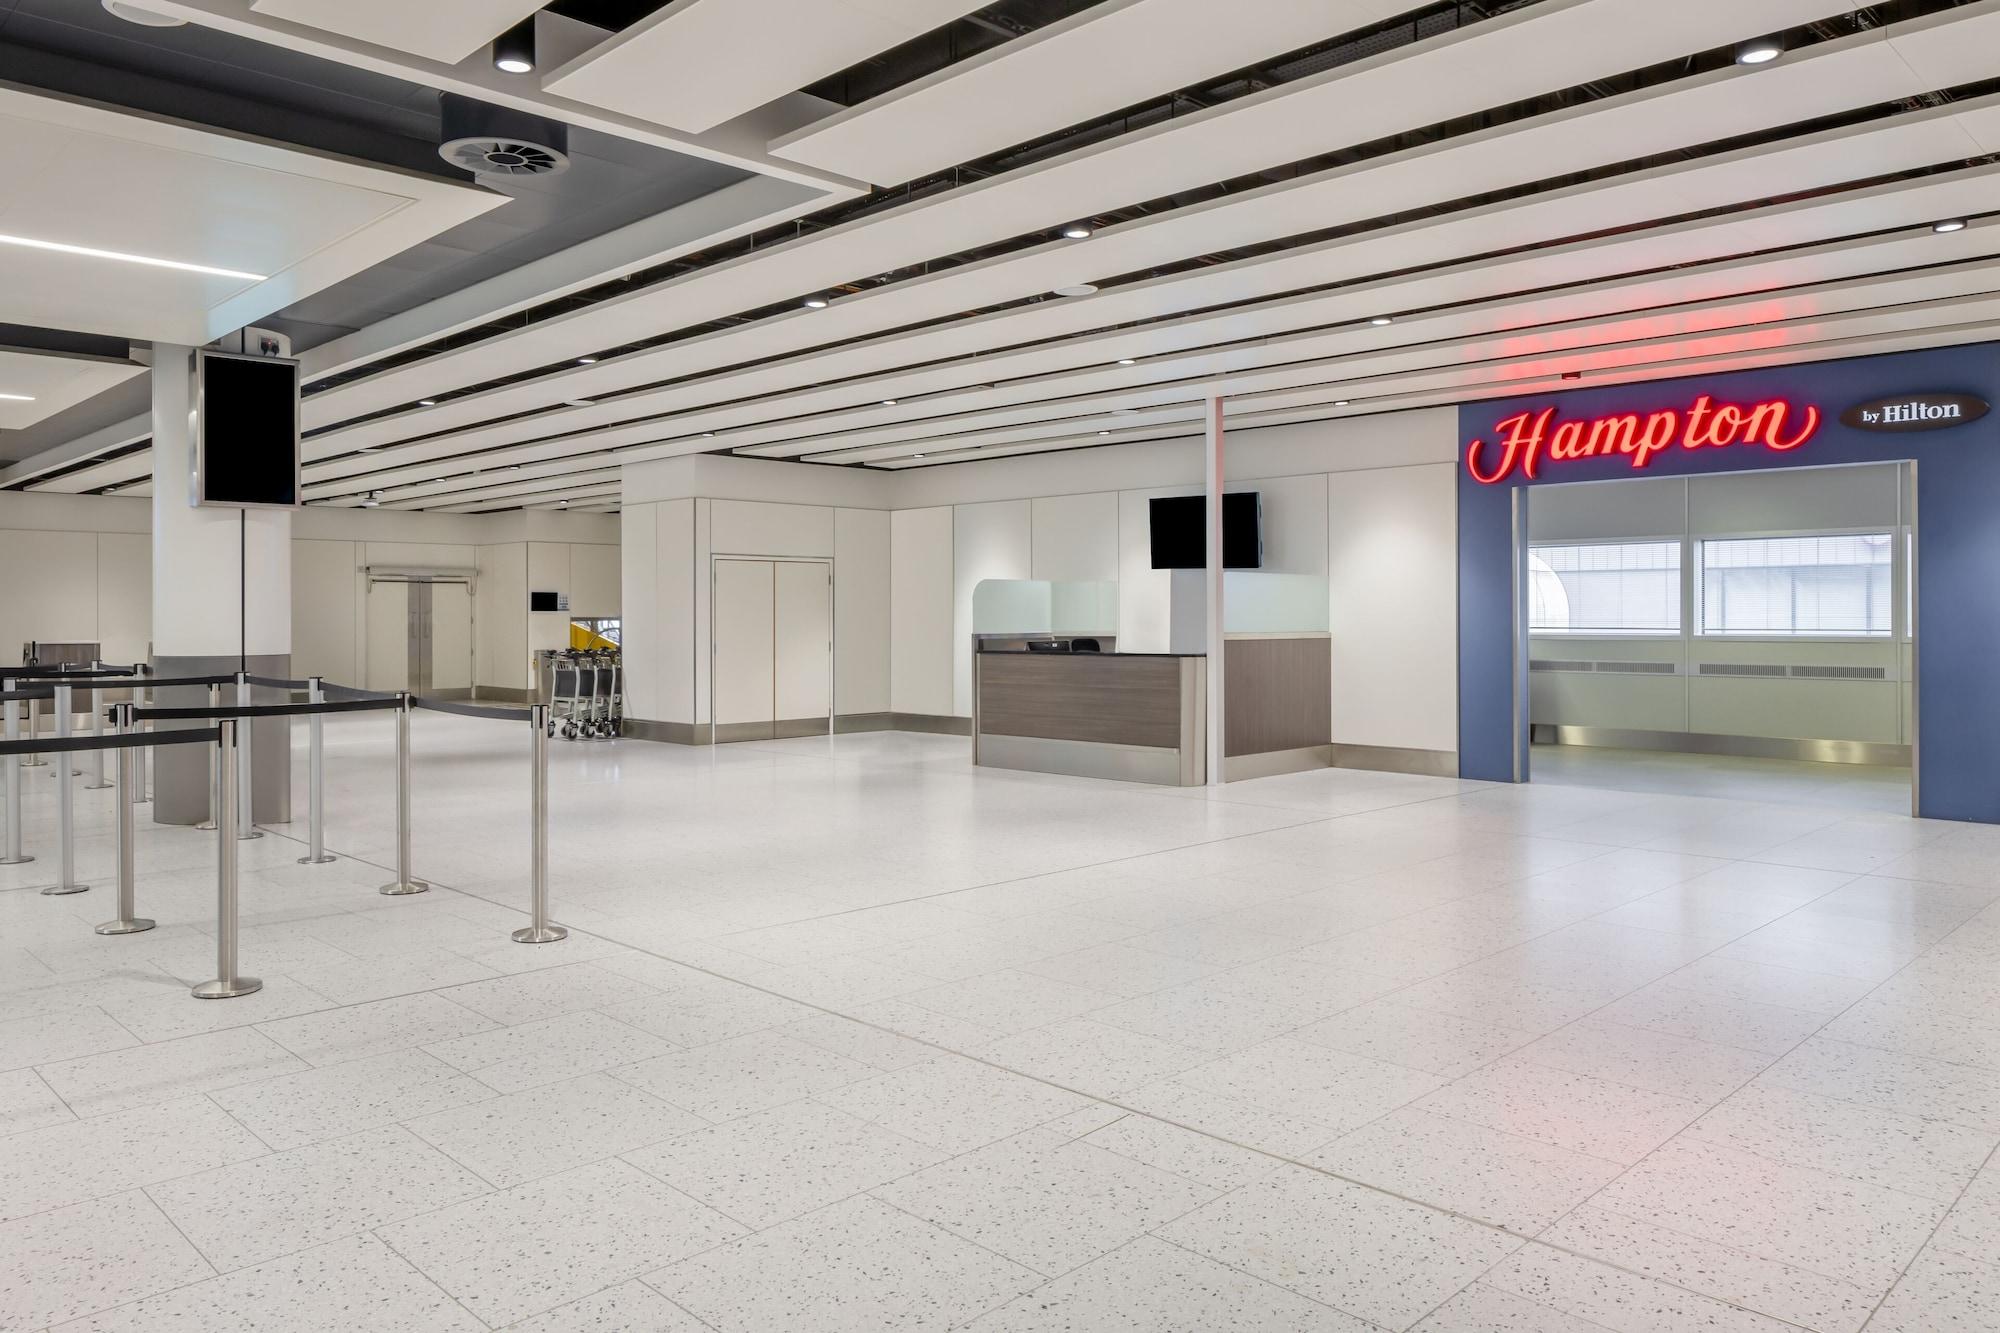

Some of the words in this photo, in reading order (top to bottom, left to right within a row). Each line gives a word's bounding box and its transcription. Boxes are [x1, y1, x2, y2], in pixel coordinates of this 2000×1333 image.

[1468, 395, 1819, 483] Hampton
[1862, 411, 1880, 423] by
[1882, 402, 1961, 423] Hilton
